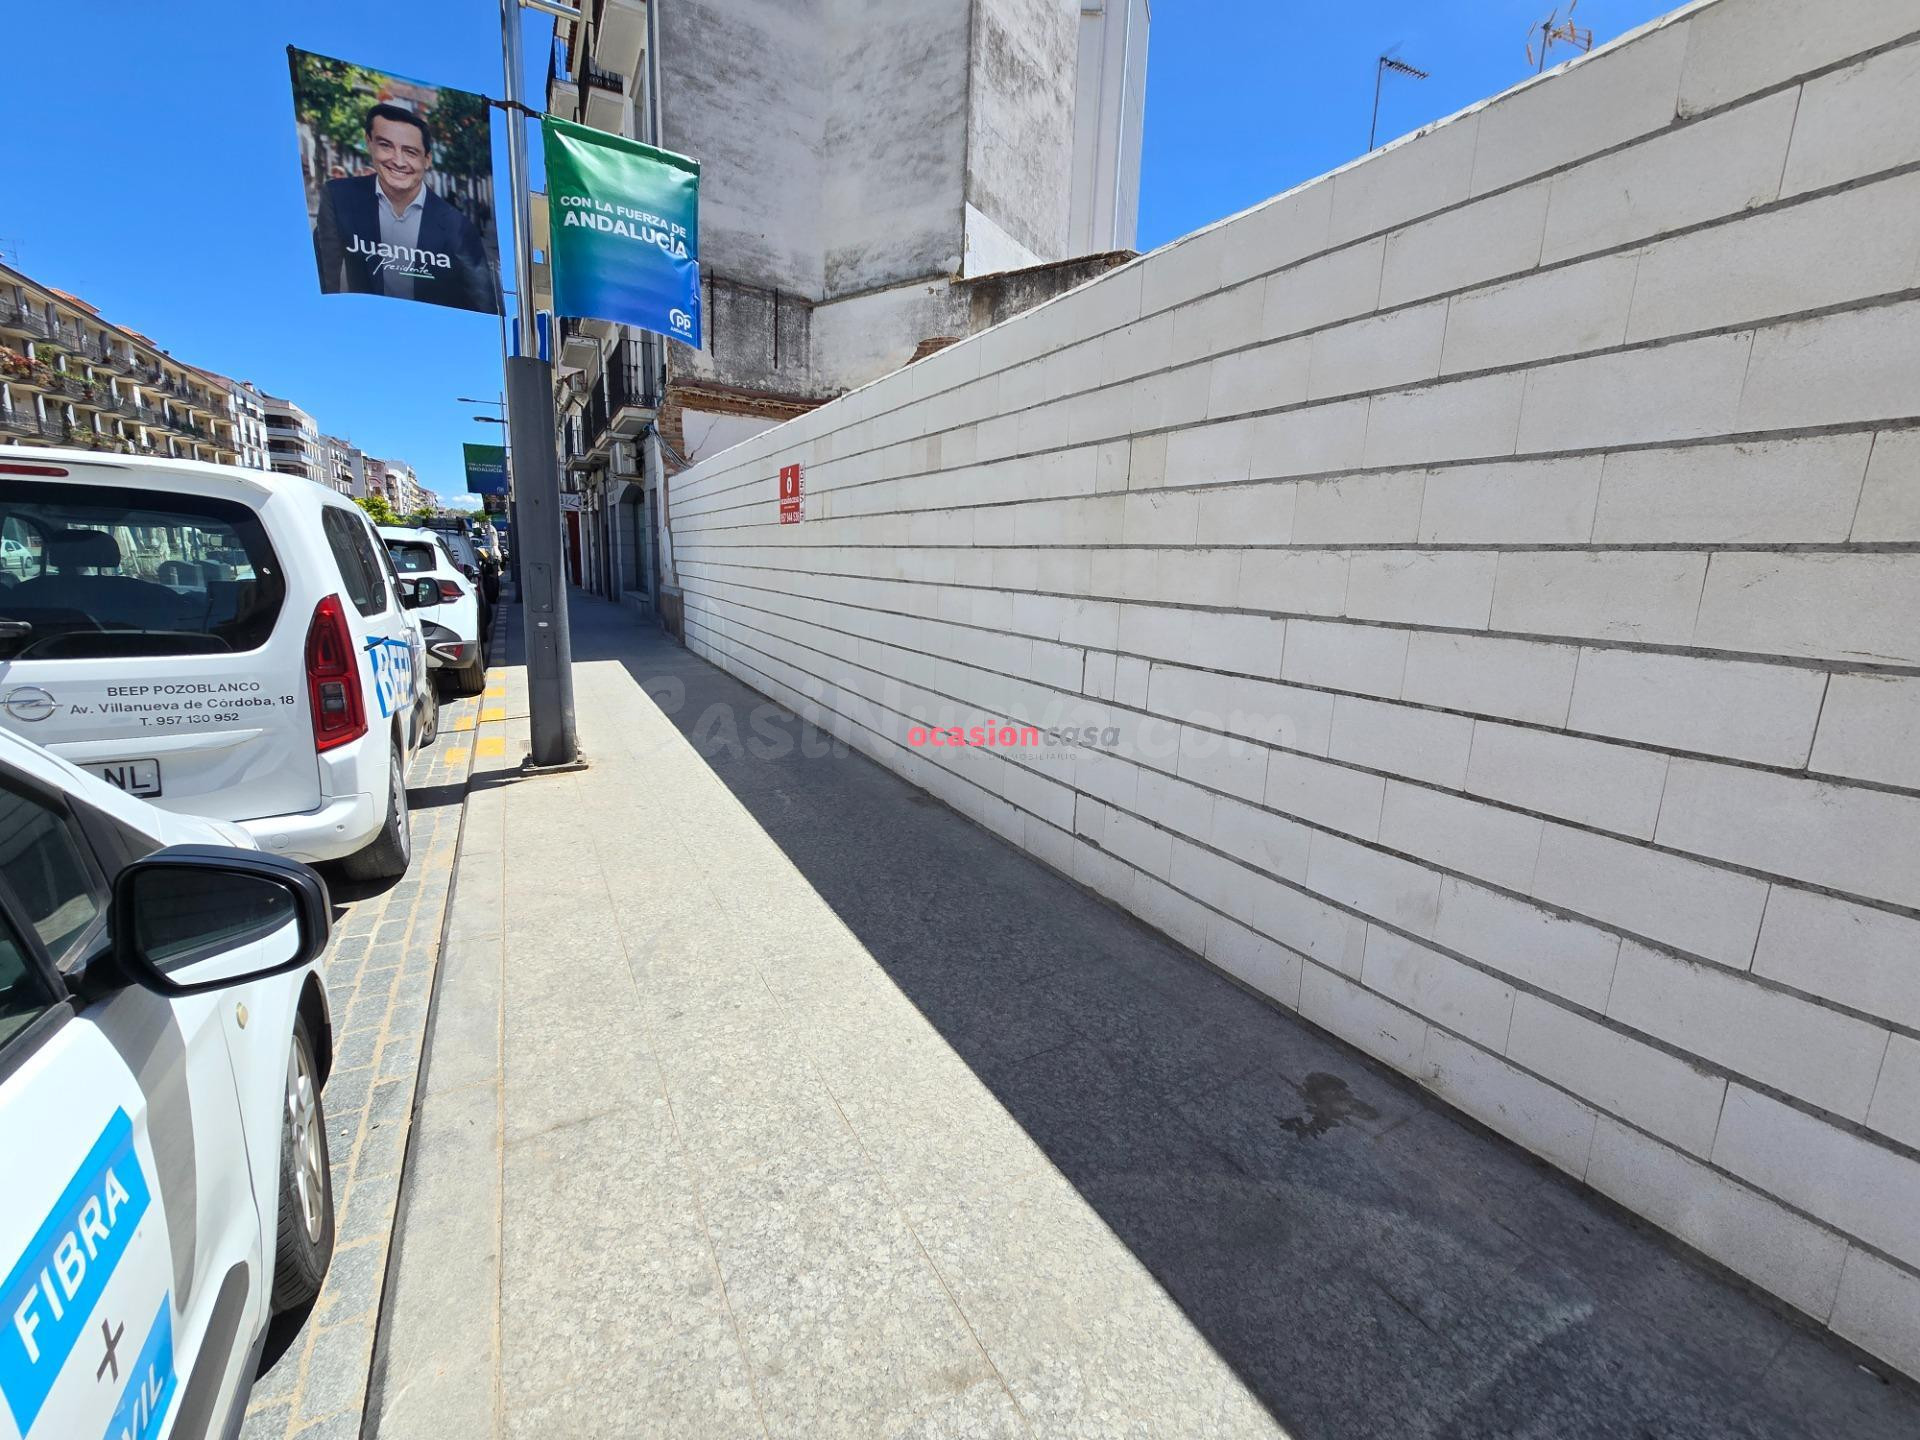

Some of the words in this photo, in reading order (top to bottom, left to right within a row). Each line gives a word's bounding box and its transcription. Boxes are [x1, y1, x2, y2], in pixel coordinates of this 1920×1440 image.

[560, 196, 591, 208] CON
[595, 200, 613, 214] LA
[617, 206, 668, 230] FUERZA
[671, 223, 687, 239] DE
[563, 210, 688, 260] ANDALUCÍA
[346, 233, 451, 269] Juanma
[365, 255, 433, 277] Presidente
[107, 686, 149, 697] BEEP
[153, 682, 260, 695] POZOBLANCO
[375, 644, 413, 712] BEEP
[70, 705, 94, 715] Av.
[98, 702, 179, 713] Villanueva
[184, 700, 203, 710] de
[207, 697, 276, 709] Córdoba,
[280, 695, 295, 705] 18
[140, 717, 152, 726] T.
[156, 715, 182, 726] 957
[214, 713, 240, 722] 952
[13, 1166, 130, 1365] FIBRA
